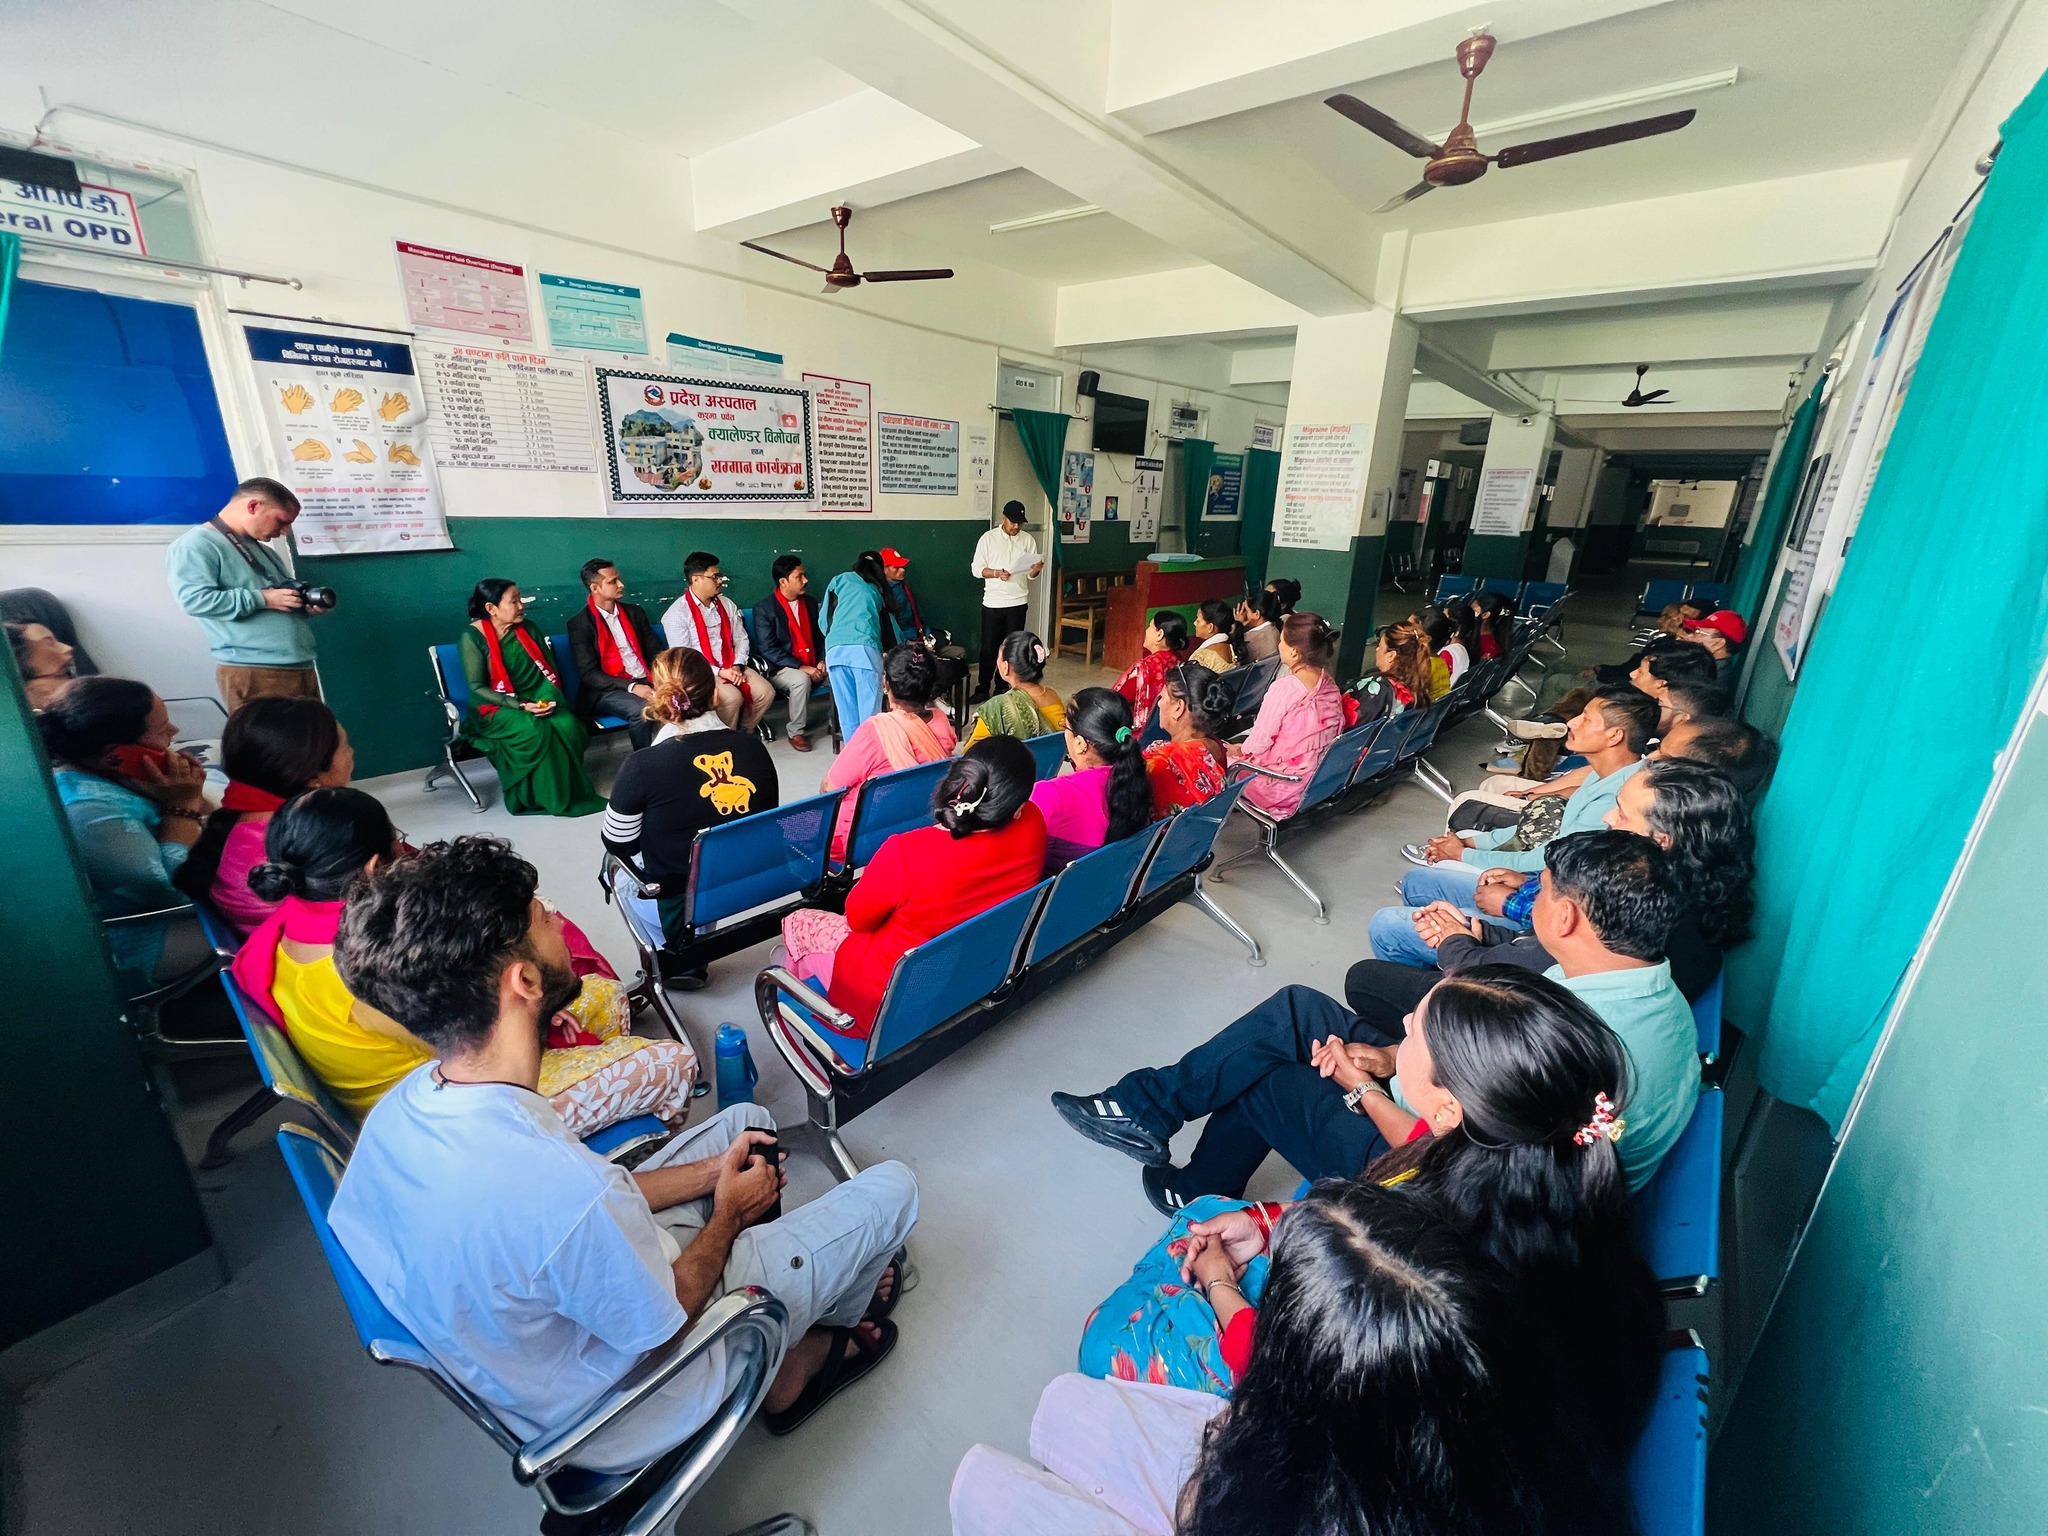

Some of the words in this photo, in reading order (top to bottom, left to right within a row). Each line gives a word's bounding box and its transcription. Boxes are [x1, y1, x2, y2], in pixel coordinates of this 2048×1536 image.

[63, 218, 132, 245] OPD
[407, 246, 444, 259] Management
[452, 255, 465, 263] Fluid
[466, 258, 490, 268] Overload
[698, 341, 716, 350] Dengue
[728, 347, 756, 358] Management
[670, 389, 700, 406] प्रदेश
[705, 394, 757, 410] अस्पताल
[720, 412, 735, 421] पर्वत
[708, 425, 762, 444] क्यालेण्डर
[764, 427, 800, 444] विमोचन
[1302, 426, 1328, 434] Migraine
[711, 460, 753, 474] सम्मान
[756, 458, 802, 474] कार्यक्रम
[1294, 456, 1314, 464] Migraine
